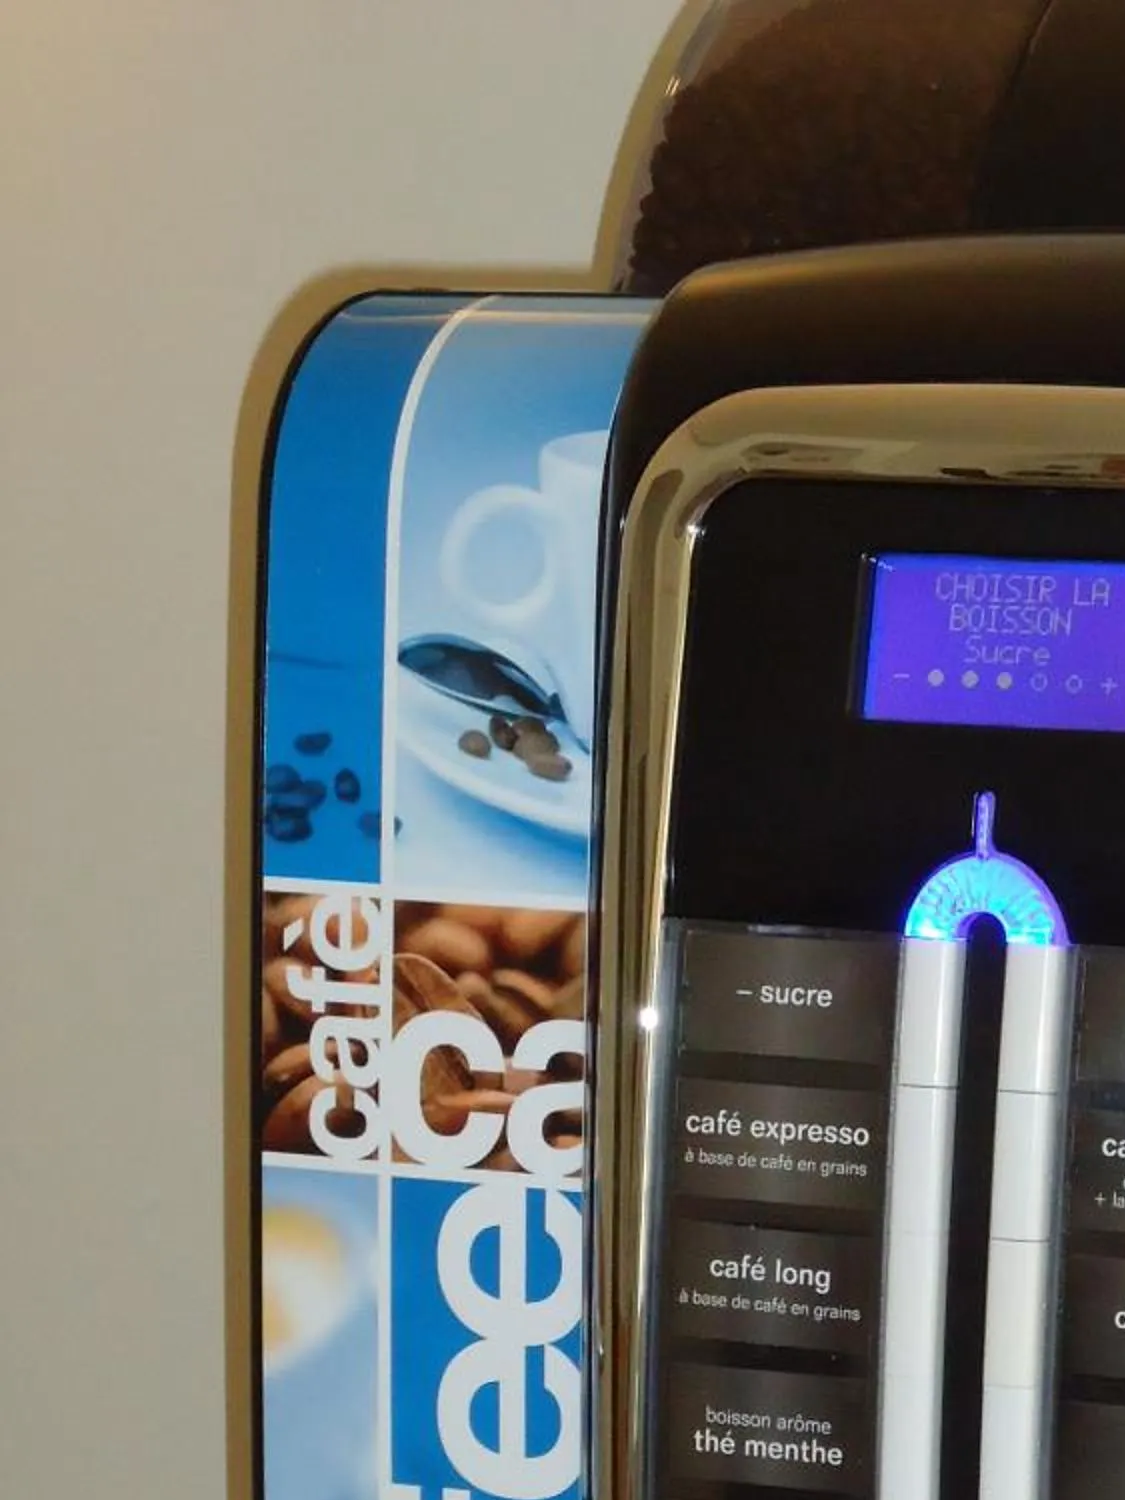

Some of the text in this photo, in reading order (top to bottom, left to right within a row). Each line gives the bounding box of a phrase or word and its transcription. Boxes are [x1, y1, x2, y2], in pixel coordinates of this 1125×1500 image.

[935, 572, 1111, 607] CHOISIR LA
[949, 604, 1073, 635] BOISSON
[964, 636, 1051, 666] Sucre
[760, 984, 833, 1008] sucre
[686, 1110, 870, 1147] café expresso
[684, 1148, 868, 1177] à base de café en grains
[709, 1255, 831, 1294] café long
[679, 1288, 861, 1322] à base de café en grains
[706, 1405, 832, 1435] boisson arôme
[693, 1429, 843, 1466] thé menthe
